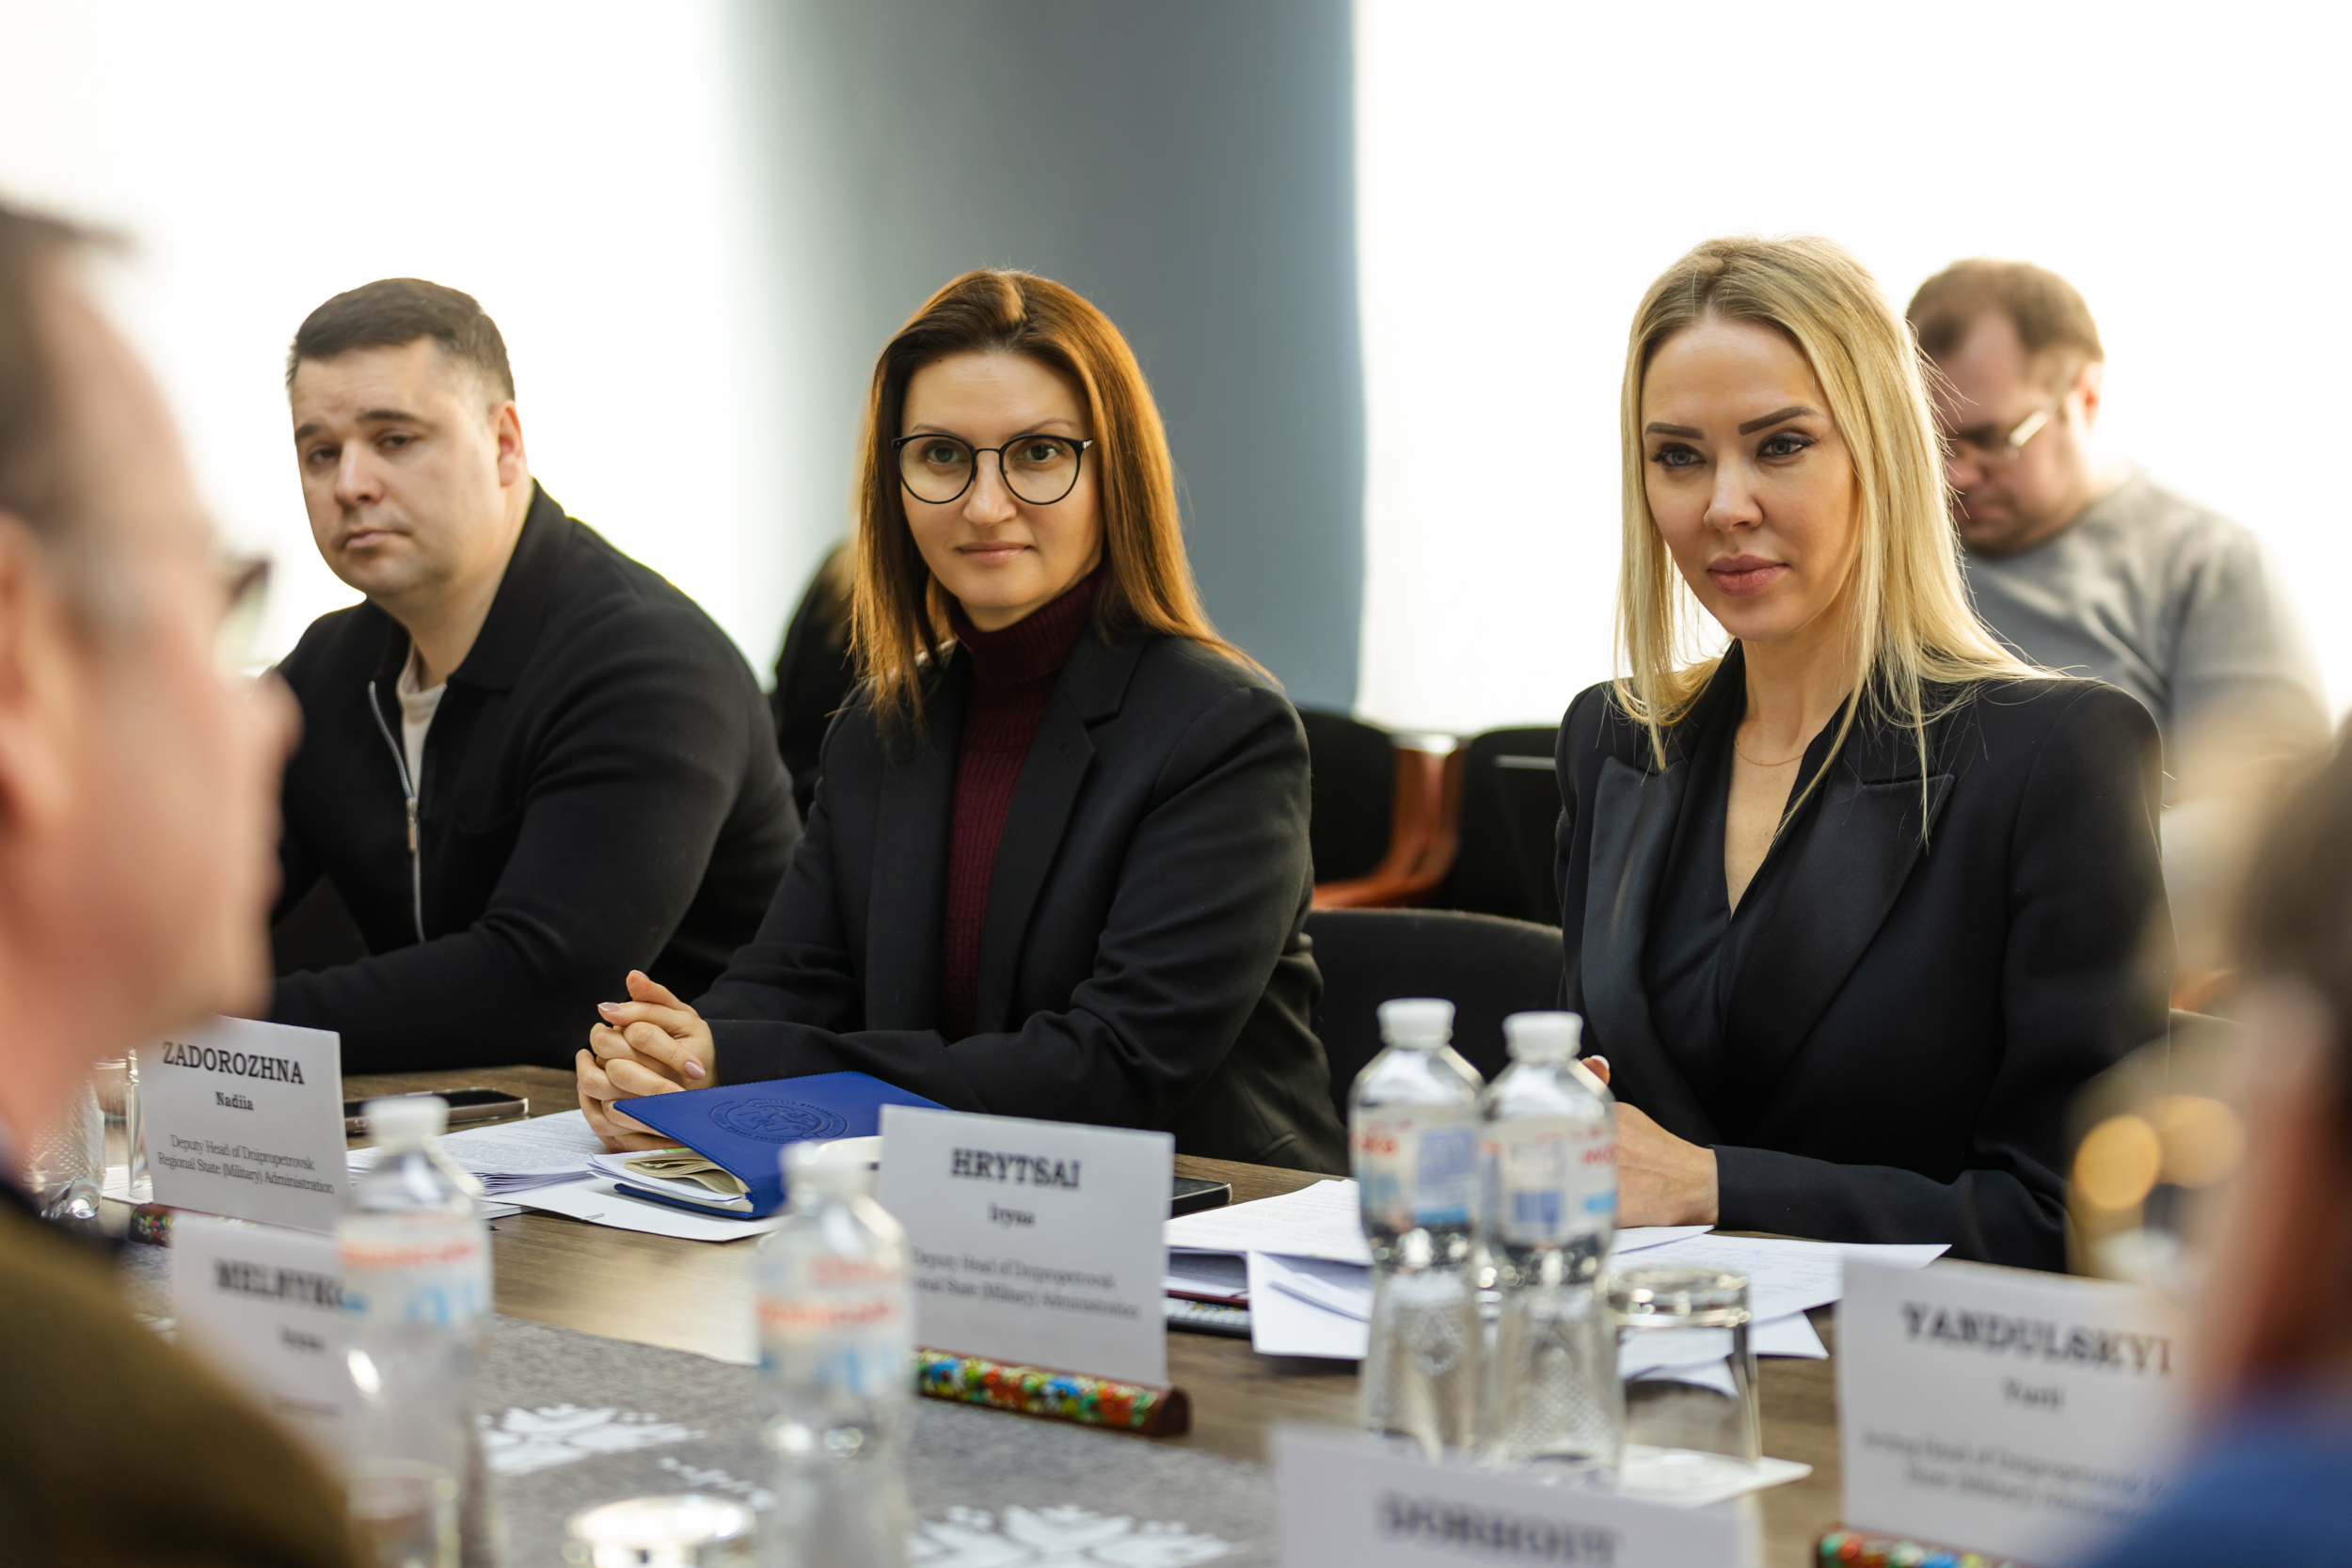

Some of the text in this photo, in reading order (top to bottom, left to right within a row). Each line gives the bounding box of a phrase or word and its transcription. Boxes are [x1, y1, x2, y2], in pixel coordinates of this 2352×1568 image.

[163, 1041, 305, 1085] ZADOROZHNA
[215, 1091, 254, 1111] Nadiia
[157, 1151, 335, 1194] Regional State (Military) Administration
[170, 1133, 315, 1170] Deputy Head of Dnipropetrovsk
[951, 1148, 1082, 1190] HRYTSAI
